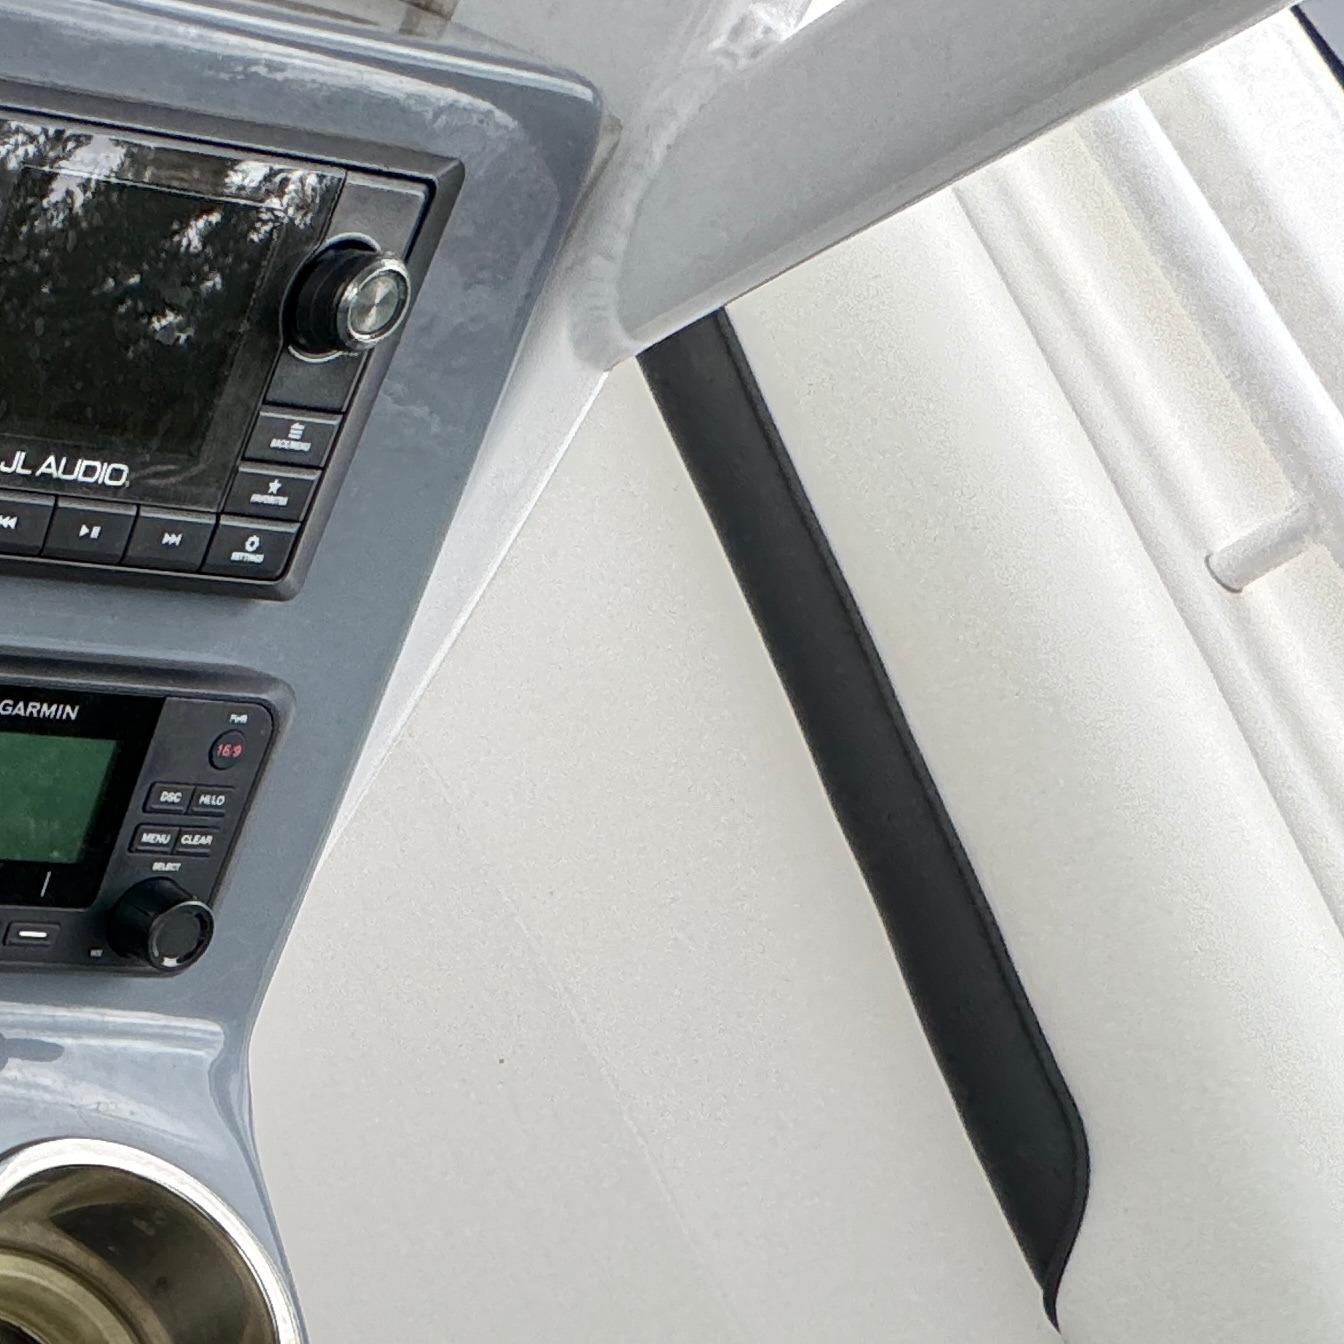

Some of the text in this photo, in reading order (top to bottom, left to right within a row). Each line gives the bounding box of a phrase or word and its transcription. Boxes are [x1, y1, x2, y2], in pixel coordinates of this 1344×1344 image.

[0, 450, 128, 487] JL AUDIO
[159, 791, 183, 804] DSC
[140, 832, 171, 845] MENU
[180, 834, 213, 846] CLEAR
